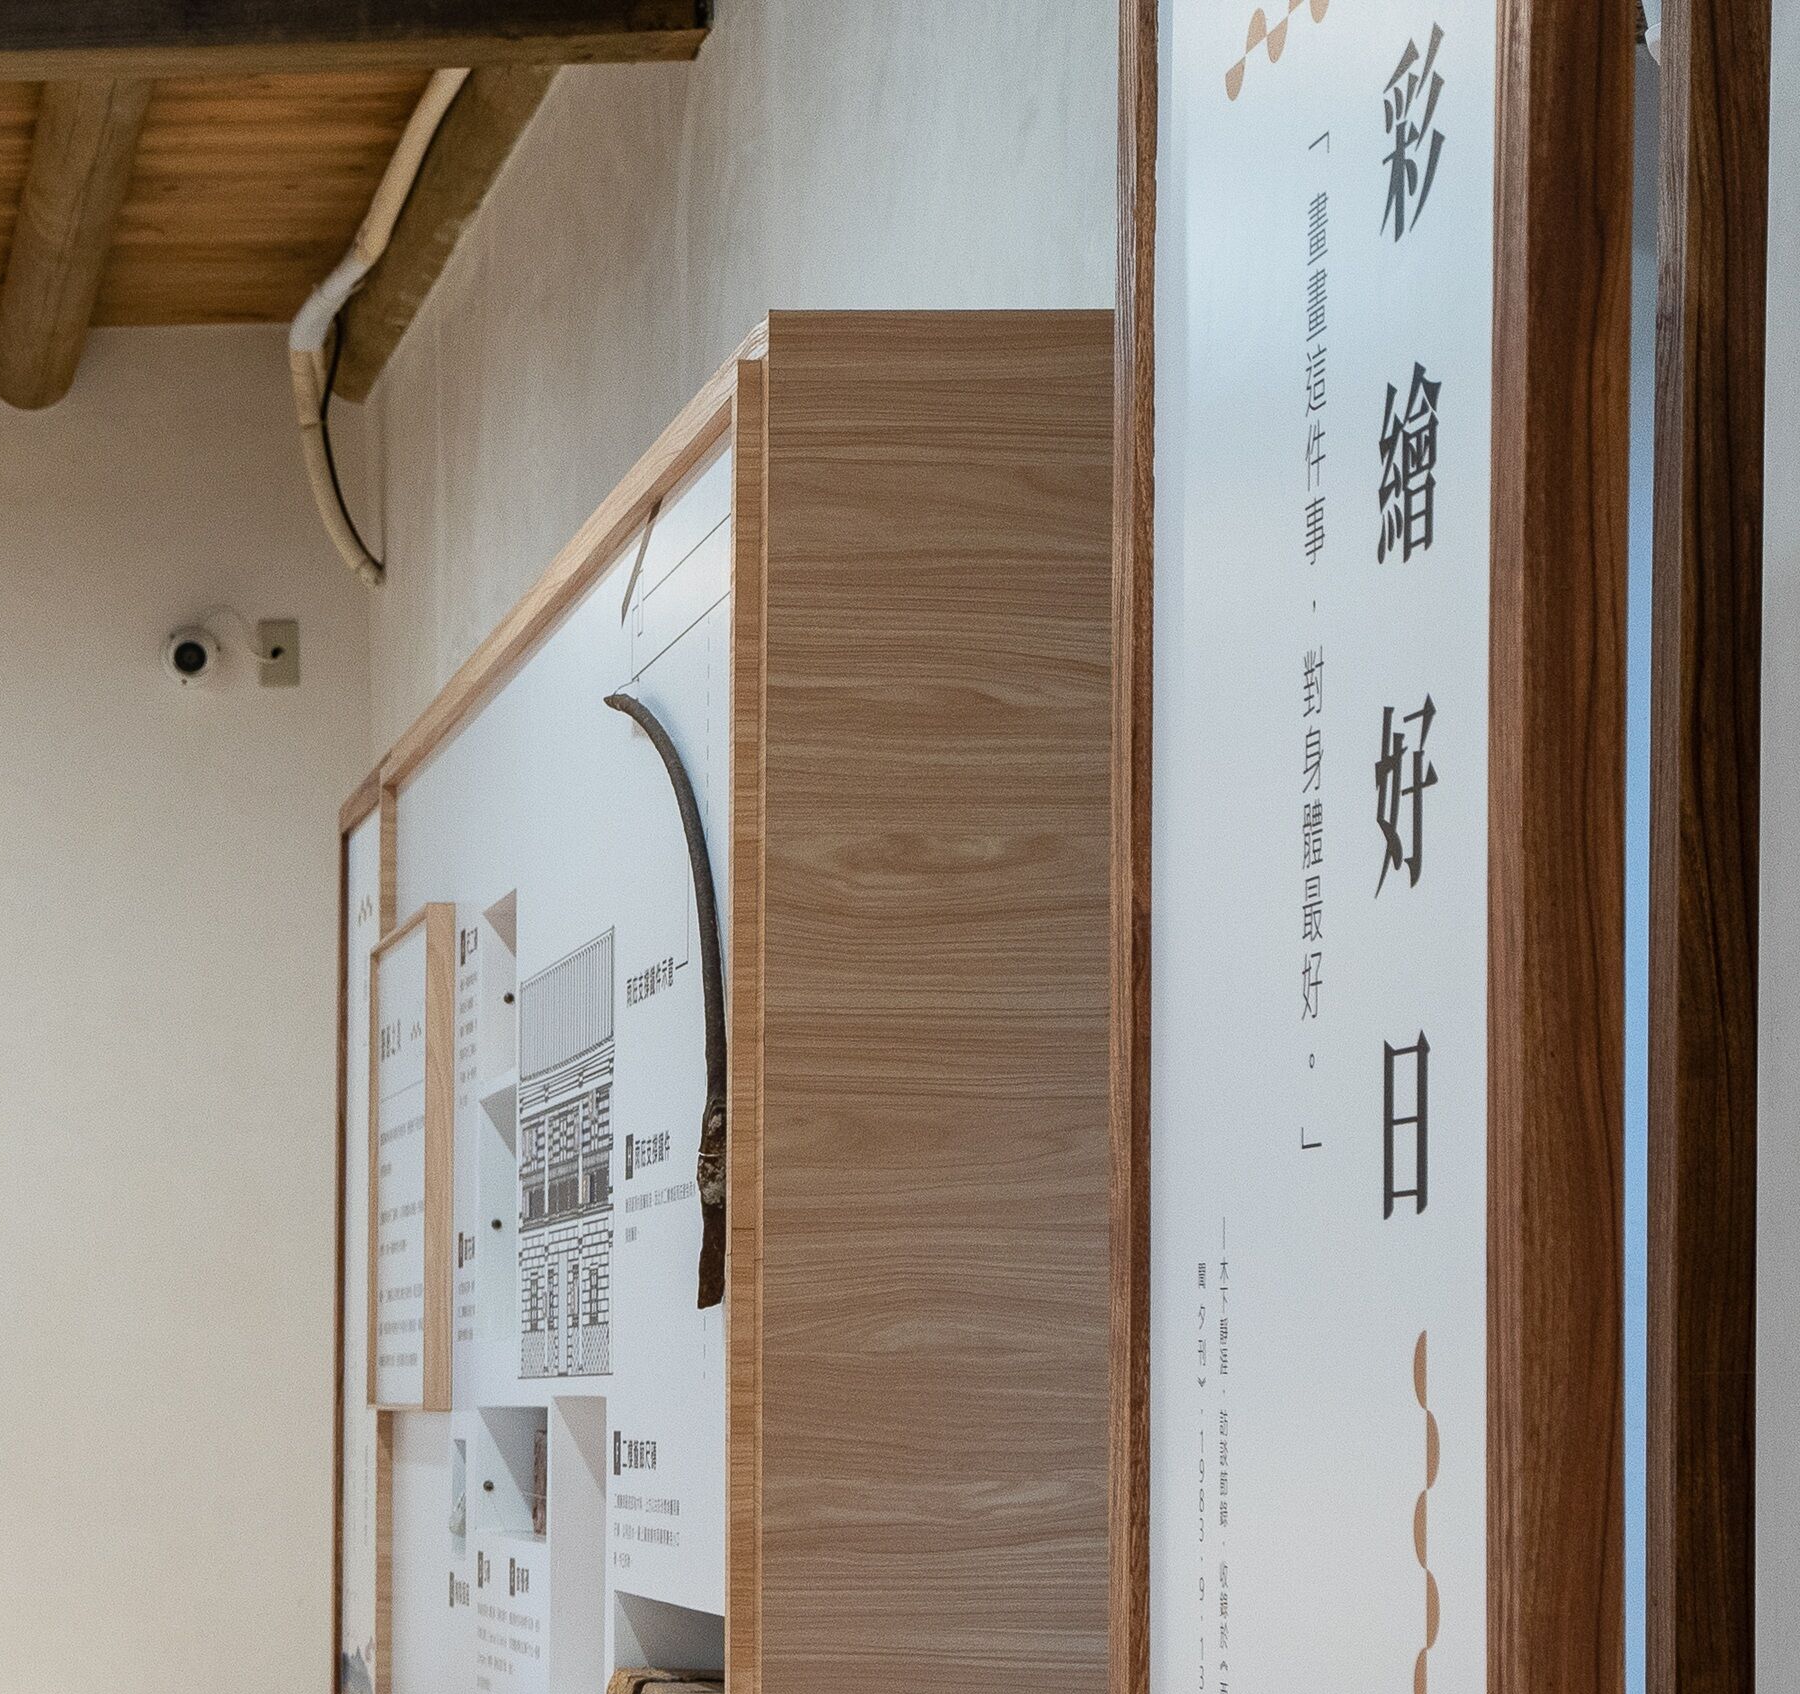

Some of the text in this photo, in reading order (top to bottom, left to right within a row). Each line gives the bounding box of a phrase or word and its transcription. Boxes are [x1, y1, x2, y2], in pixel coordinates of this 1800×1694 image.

[1299, 128, 1331, 1152] 「畫畫這件事，對身體最好。」
[1374, 22, 1447, 1220] 彩繪好日
